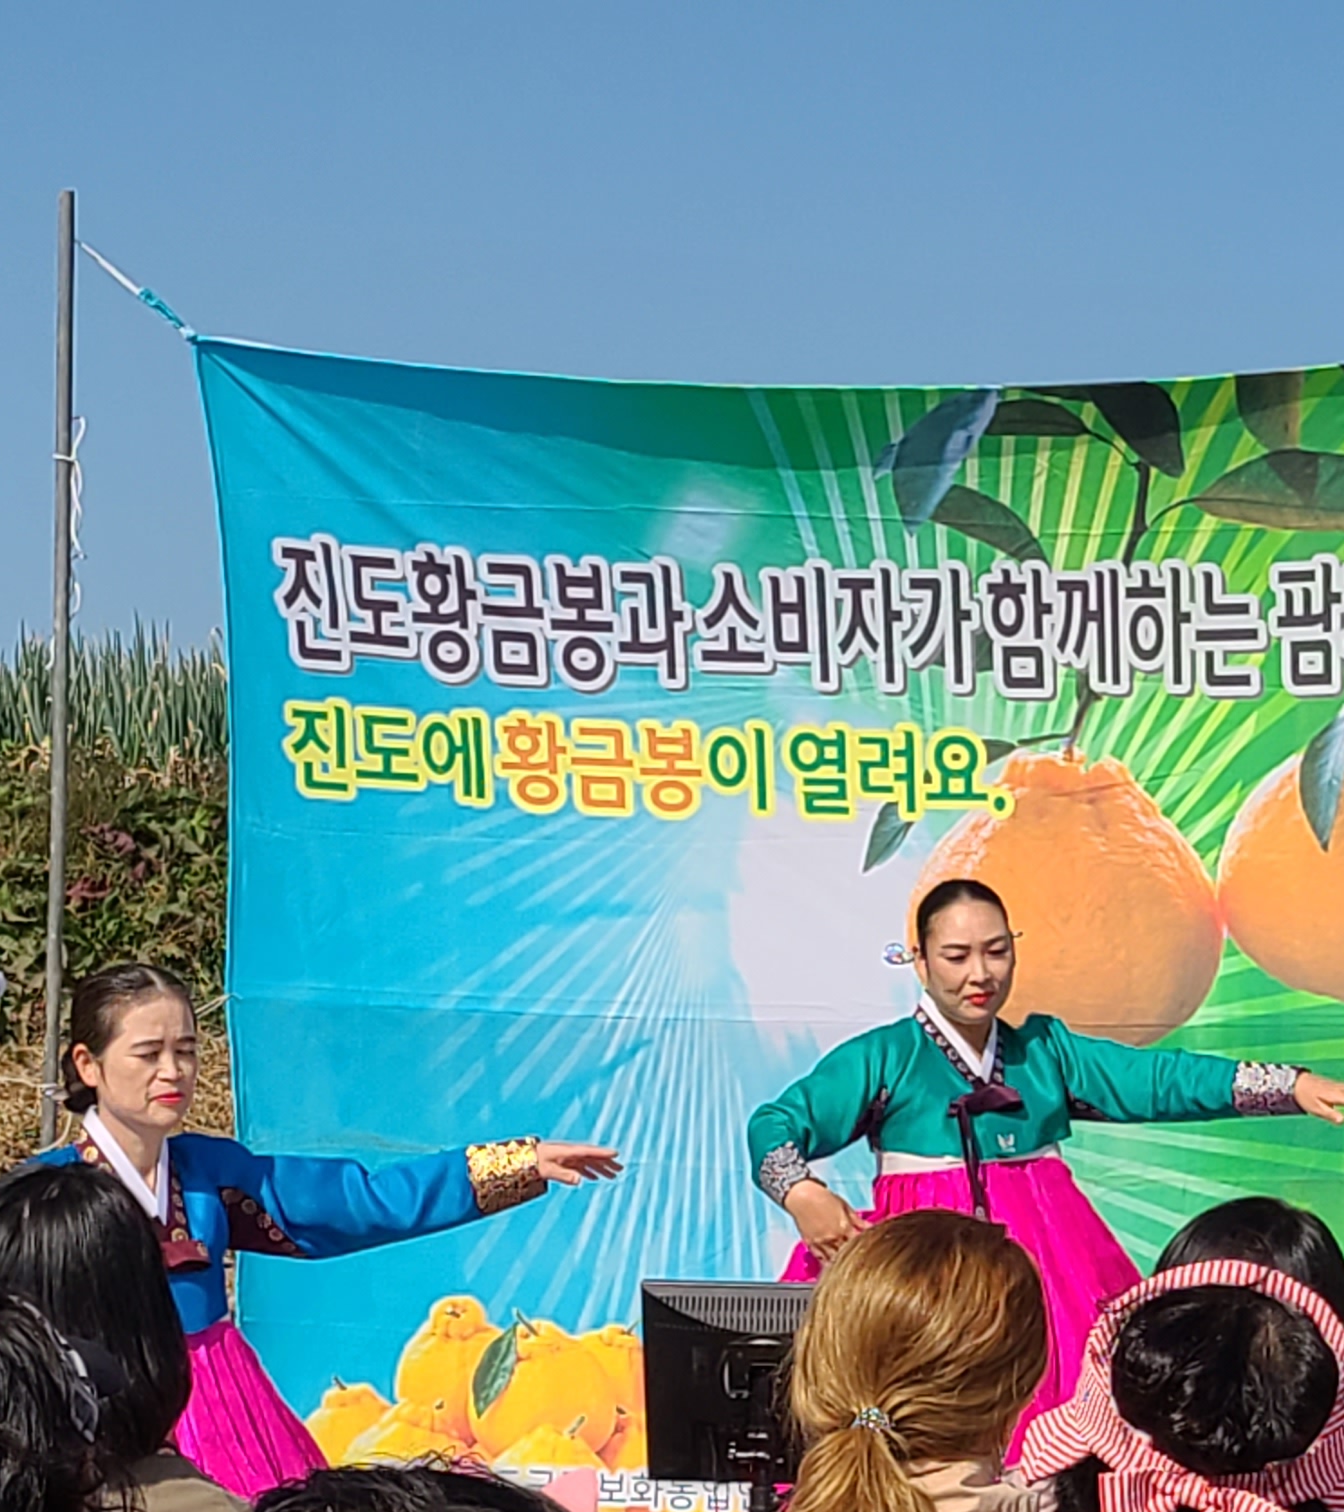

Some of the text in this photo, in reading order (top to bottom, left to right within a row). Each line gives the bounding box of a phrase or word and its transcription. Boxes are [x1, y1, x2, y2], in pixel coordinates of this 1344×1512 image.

[278, 538, 687, 684] 진도황금봉과
[698, 564, 974, 688] 소비자가
[984, 565, 1261, 691] 함께하는
[288, 703, 1009, 817] 진도에 황금봉이 열려요.
